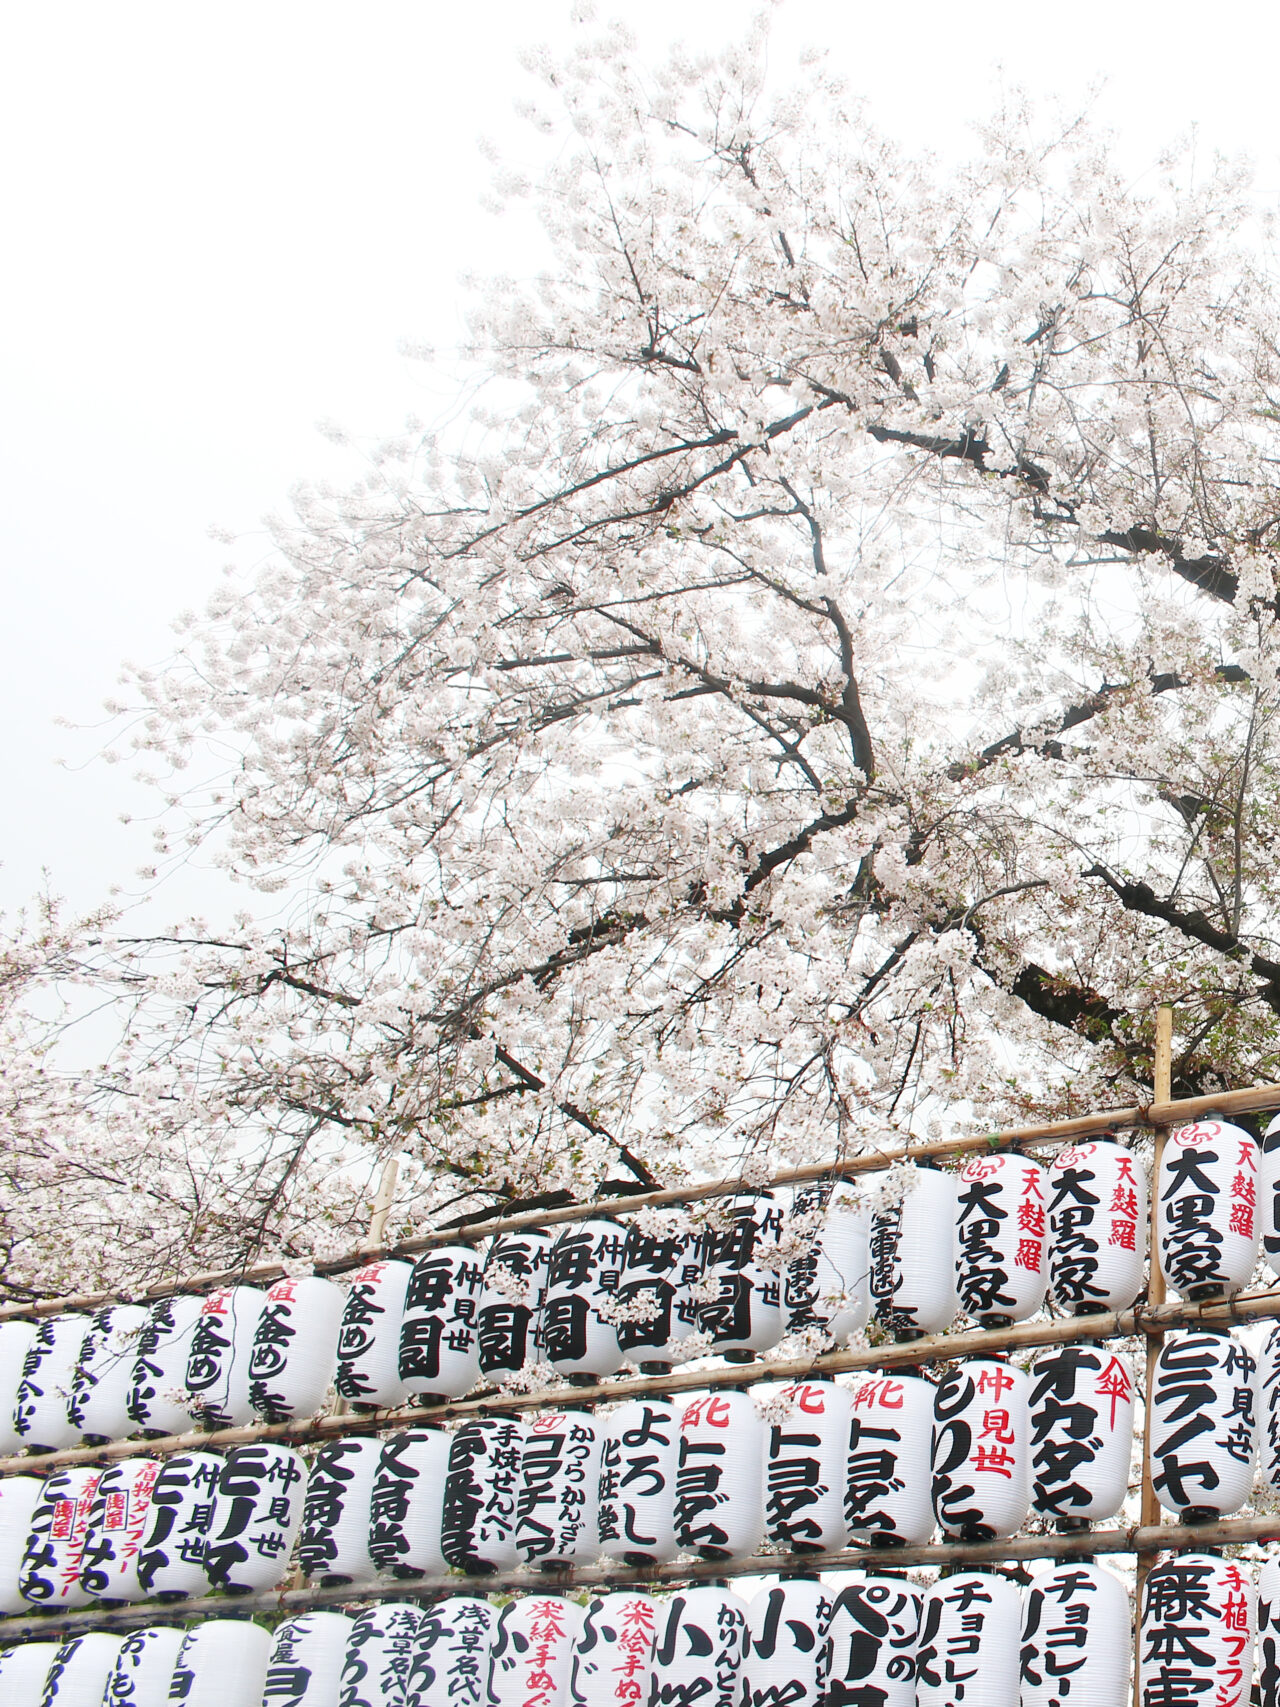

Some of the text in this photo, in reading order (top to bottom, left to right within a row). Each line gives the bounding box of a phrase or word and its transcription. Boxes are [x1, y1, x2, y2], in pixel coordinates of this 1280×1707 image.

[756, 1207, 784, 1307] 仲世
[956, 1181, 1016, 1314] 大黒家
[1047, 1169, 1110, 1305] 大黒家
[1160, 1148, 1230, 1290] 大黒家
[442, 1260, 485, 1353] 仲見世
[679, 1397, 731, 1430] 靴
[852, 1379, 904, 1412] 靴
[969, 1367, 1015, 1479] 仲見世
[1028, 1349, 1104, 1516] オカダヤ
[1095, 1356, 1132, 1432] 傘
[1215, 1344, 1256, 1463] 仲見世
[175, 1463, 221, 1565] 仲見世
[250, 1456, 300, 1558] 仲見世
[480, 1425, 523, 1542] 手焼せんべい
[620, 1407, 671, 1545] よろし
[673, 1435, 729, 1548] トヨダヤ
[766, 1425, 829, 1543] トヨダヤ
[844, 1418, 905, 1532] トヨダヤ
[381, 1611, 422, 1707] 浅草名代
[447, 1604, 491, 1707] 浅草名代
[487, 1601, 529, 1707] ふじ
[571, 1600, 617, 1707] ふじ
[612, 1600, 654, 1707] 染絵手ぬ
[715, 1604, 744, 1707] かりんと
[944, 1581, 992, 1707] チョコレー
[1044, 1571, 1097, 1707] チョコレー
